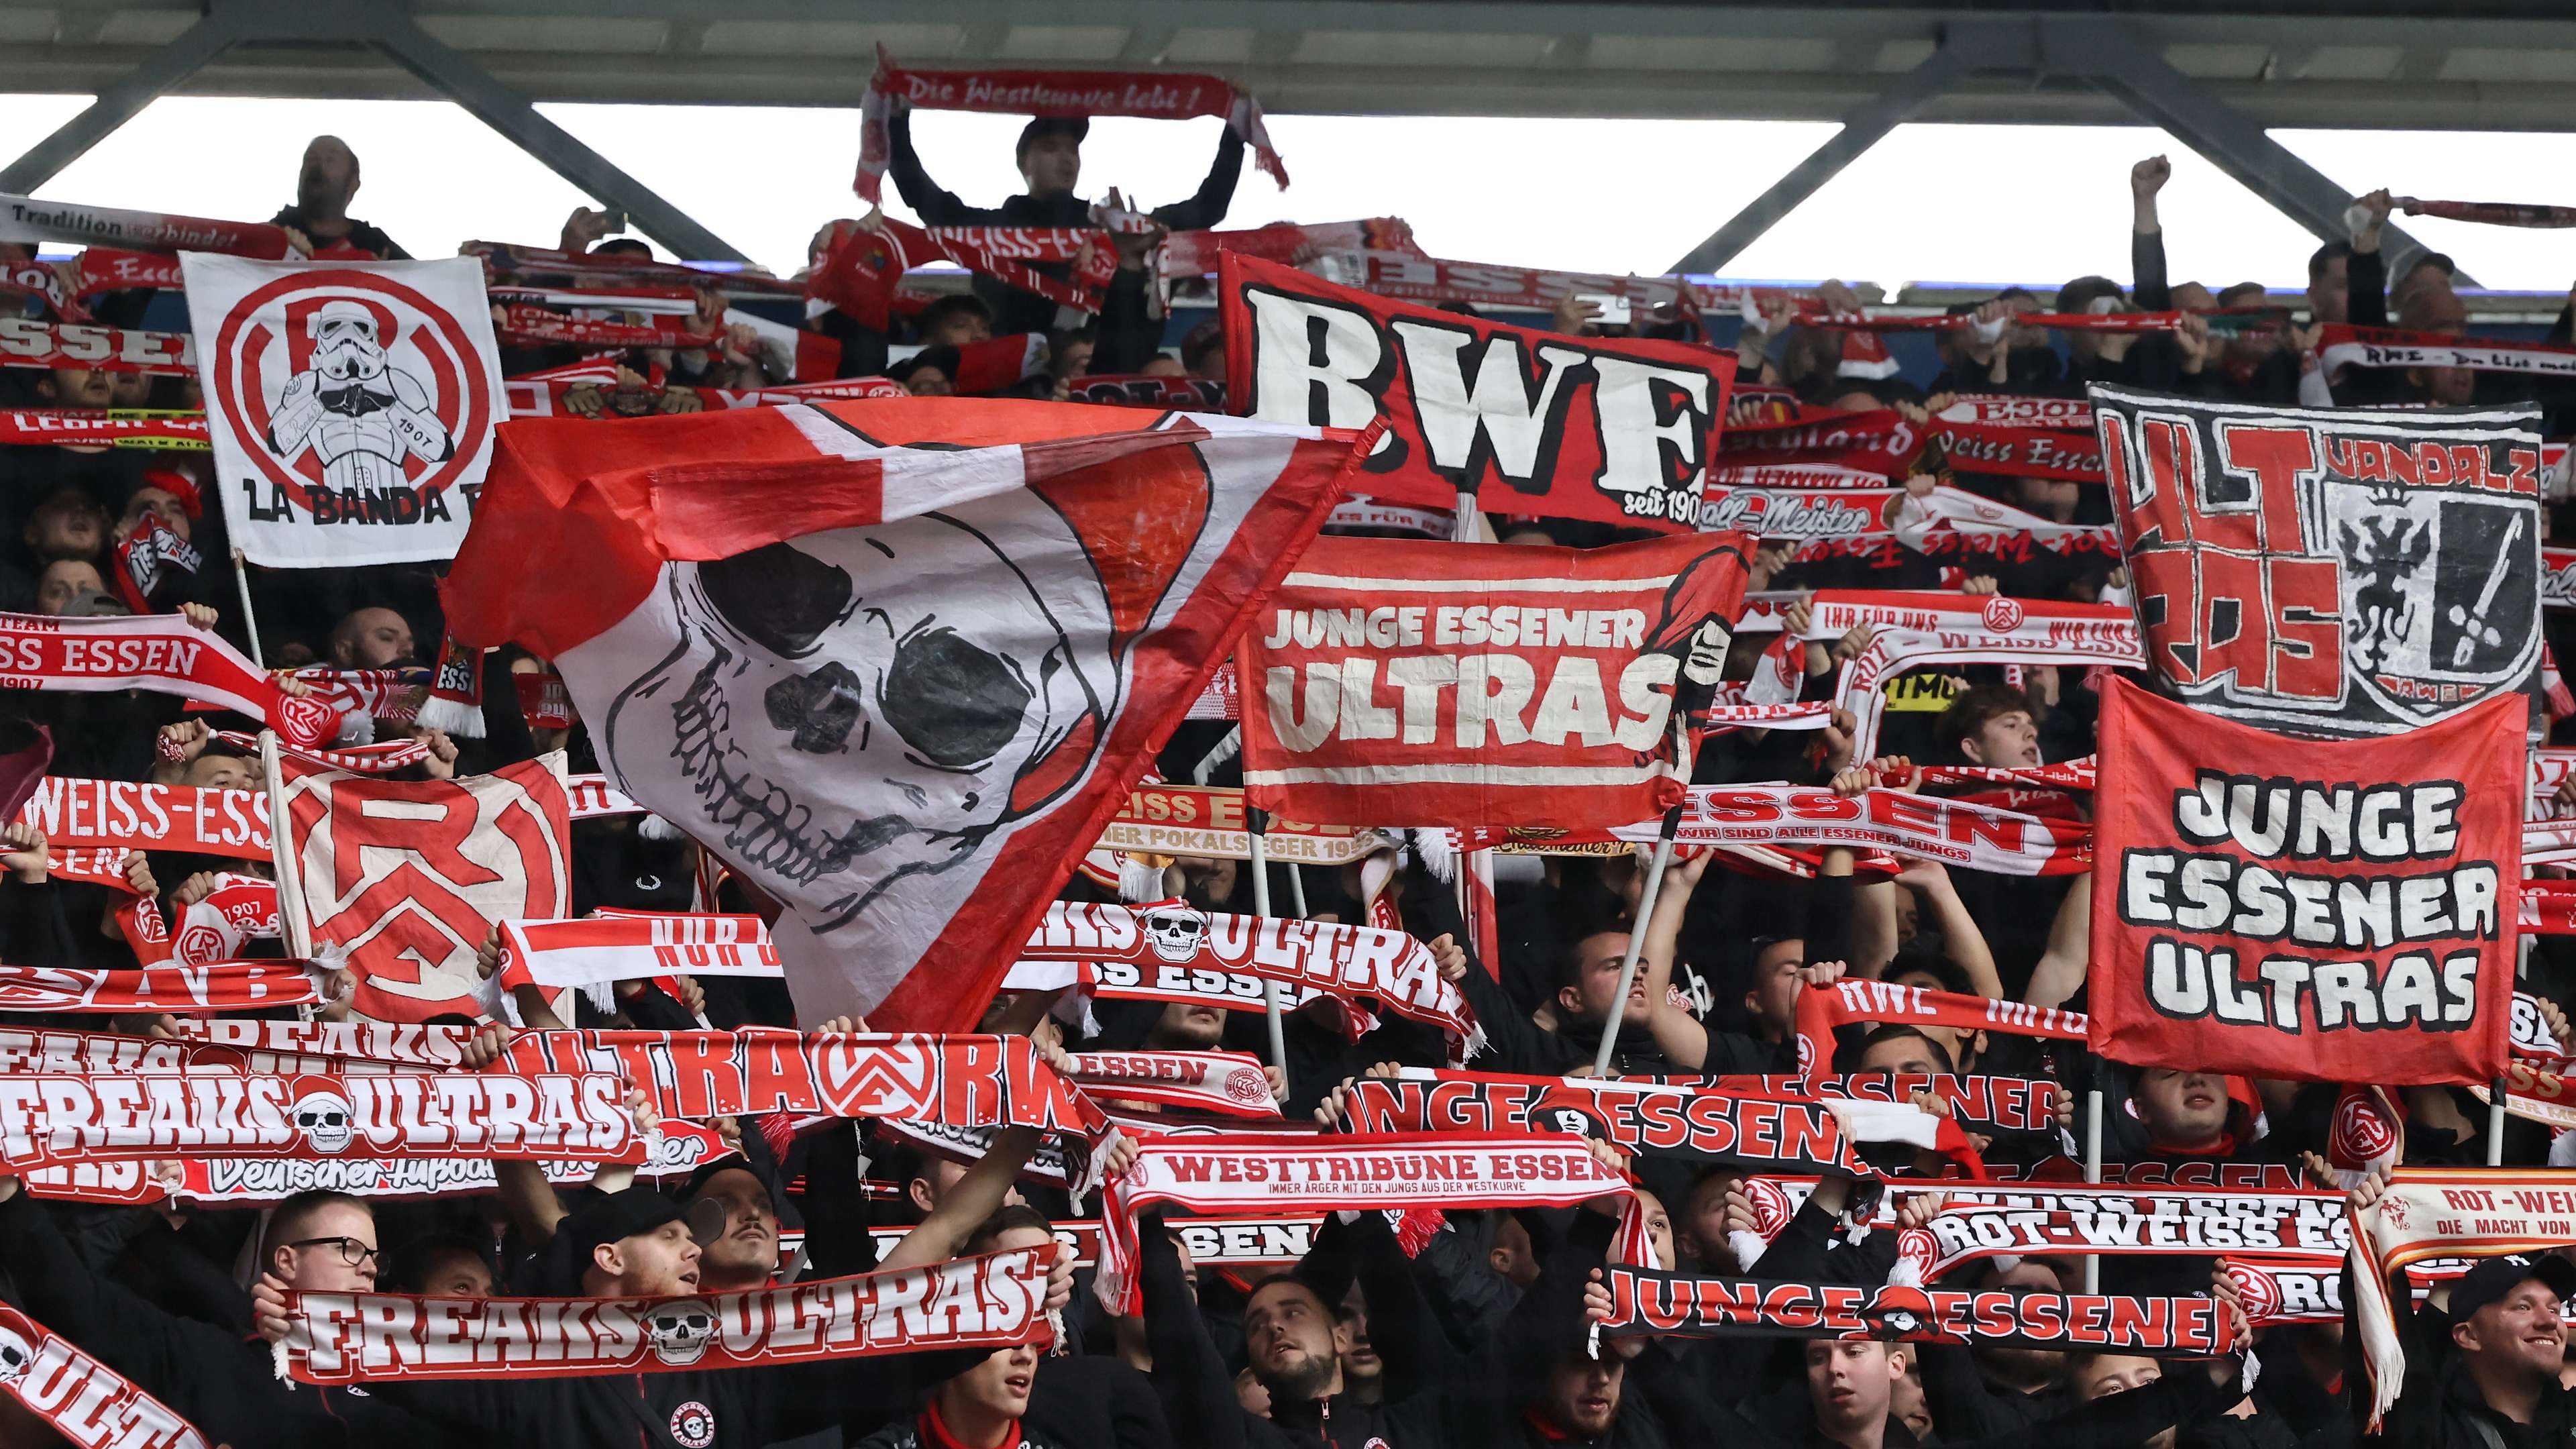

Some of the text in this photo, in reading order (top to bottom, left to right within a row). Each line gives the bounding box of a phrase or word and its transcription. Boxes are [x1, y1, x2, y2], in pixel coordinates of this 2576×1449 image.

[12, 204, 122, 236] Tradition
[398, 417, 433, 448] 1907
[2027, 438, 2105, 472] Esse
[243, 478, 296, 523] LA
[303, 484, 453, 526] BANDA
[1623, 489, 1701, 527] seit 190
[1264, 604, 1646, 650] JUNGE ESSENER
[61, 639, 201, 676] ESSEN
[1266, 652, 1681, 753] ULTRAS
[2178, 776, 2460, 857] JUNGE
[1150, 827, 1318, 858] POKALSEGER
[1676, 826, 1971, 862] WIR SIND ALLE ESSENER JUNGS
[224, 902, 261, 923] 1907
[2125, 853, 2498, 947] ESSENER
[651, 919, 739, 967] NUR
[2151, 942, 2478, 1031] ULTRAS
[1075, 1054, 1208, 1085] ESSEN
[0, 1075, 631, 1155] FREAKS ULTRAS
[1165, 1154, 1621, 1183] WESTTRIBÜNE ESSEN
[1269, 1179, 1527, 1194] IMMER ÄRGER MIT DEN JUNGS AUS DER WESTKURVE
[1930, 1212, 2282, 1253] ROT-WEISS
[2436, 1219, 2571, 1235] DIE MACHT VON
[290, 1256, 1044, 1370] FREAKS ULTRAS
[1600, 1268, 1865, 1331] JUNGE
